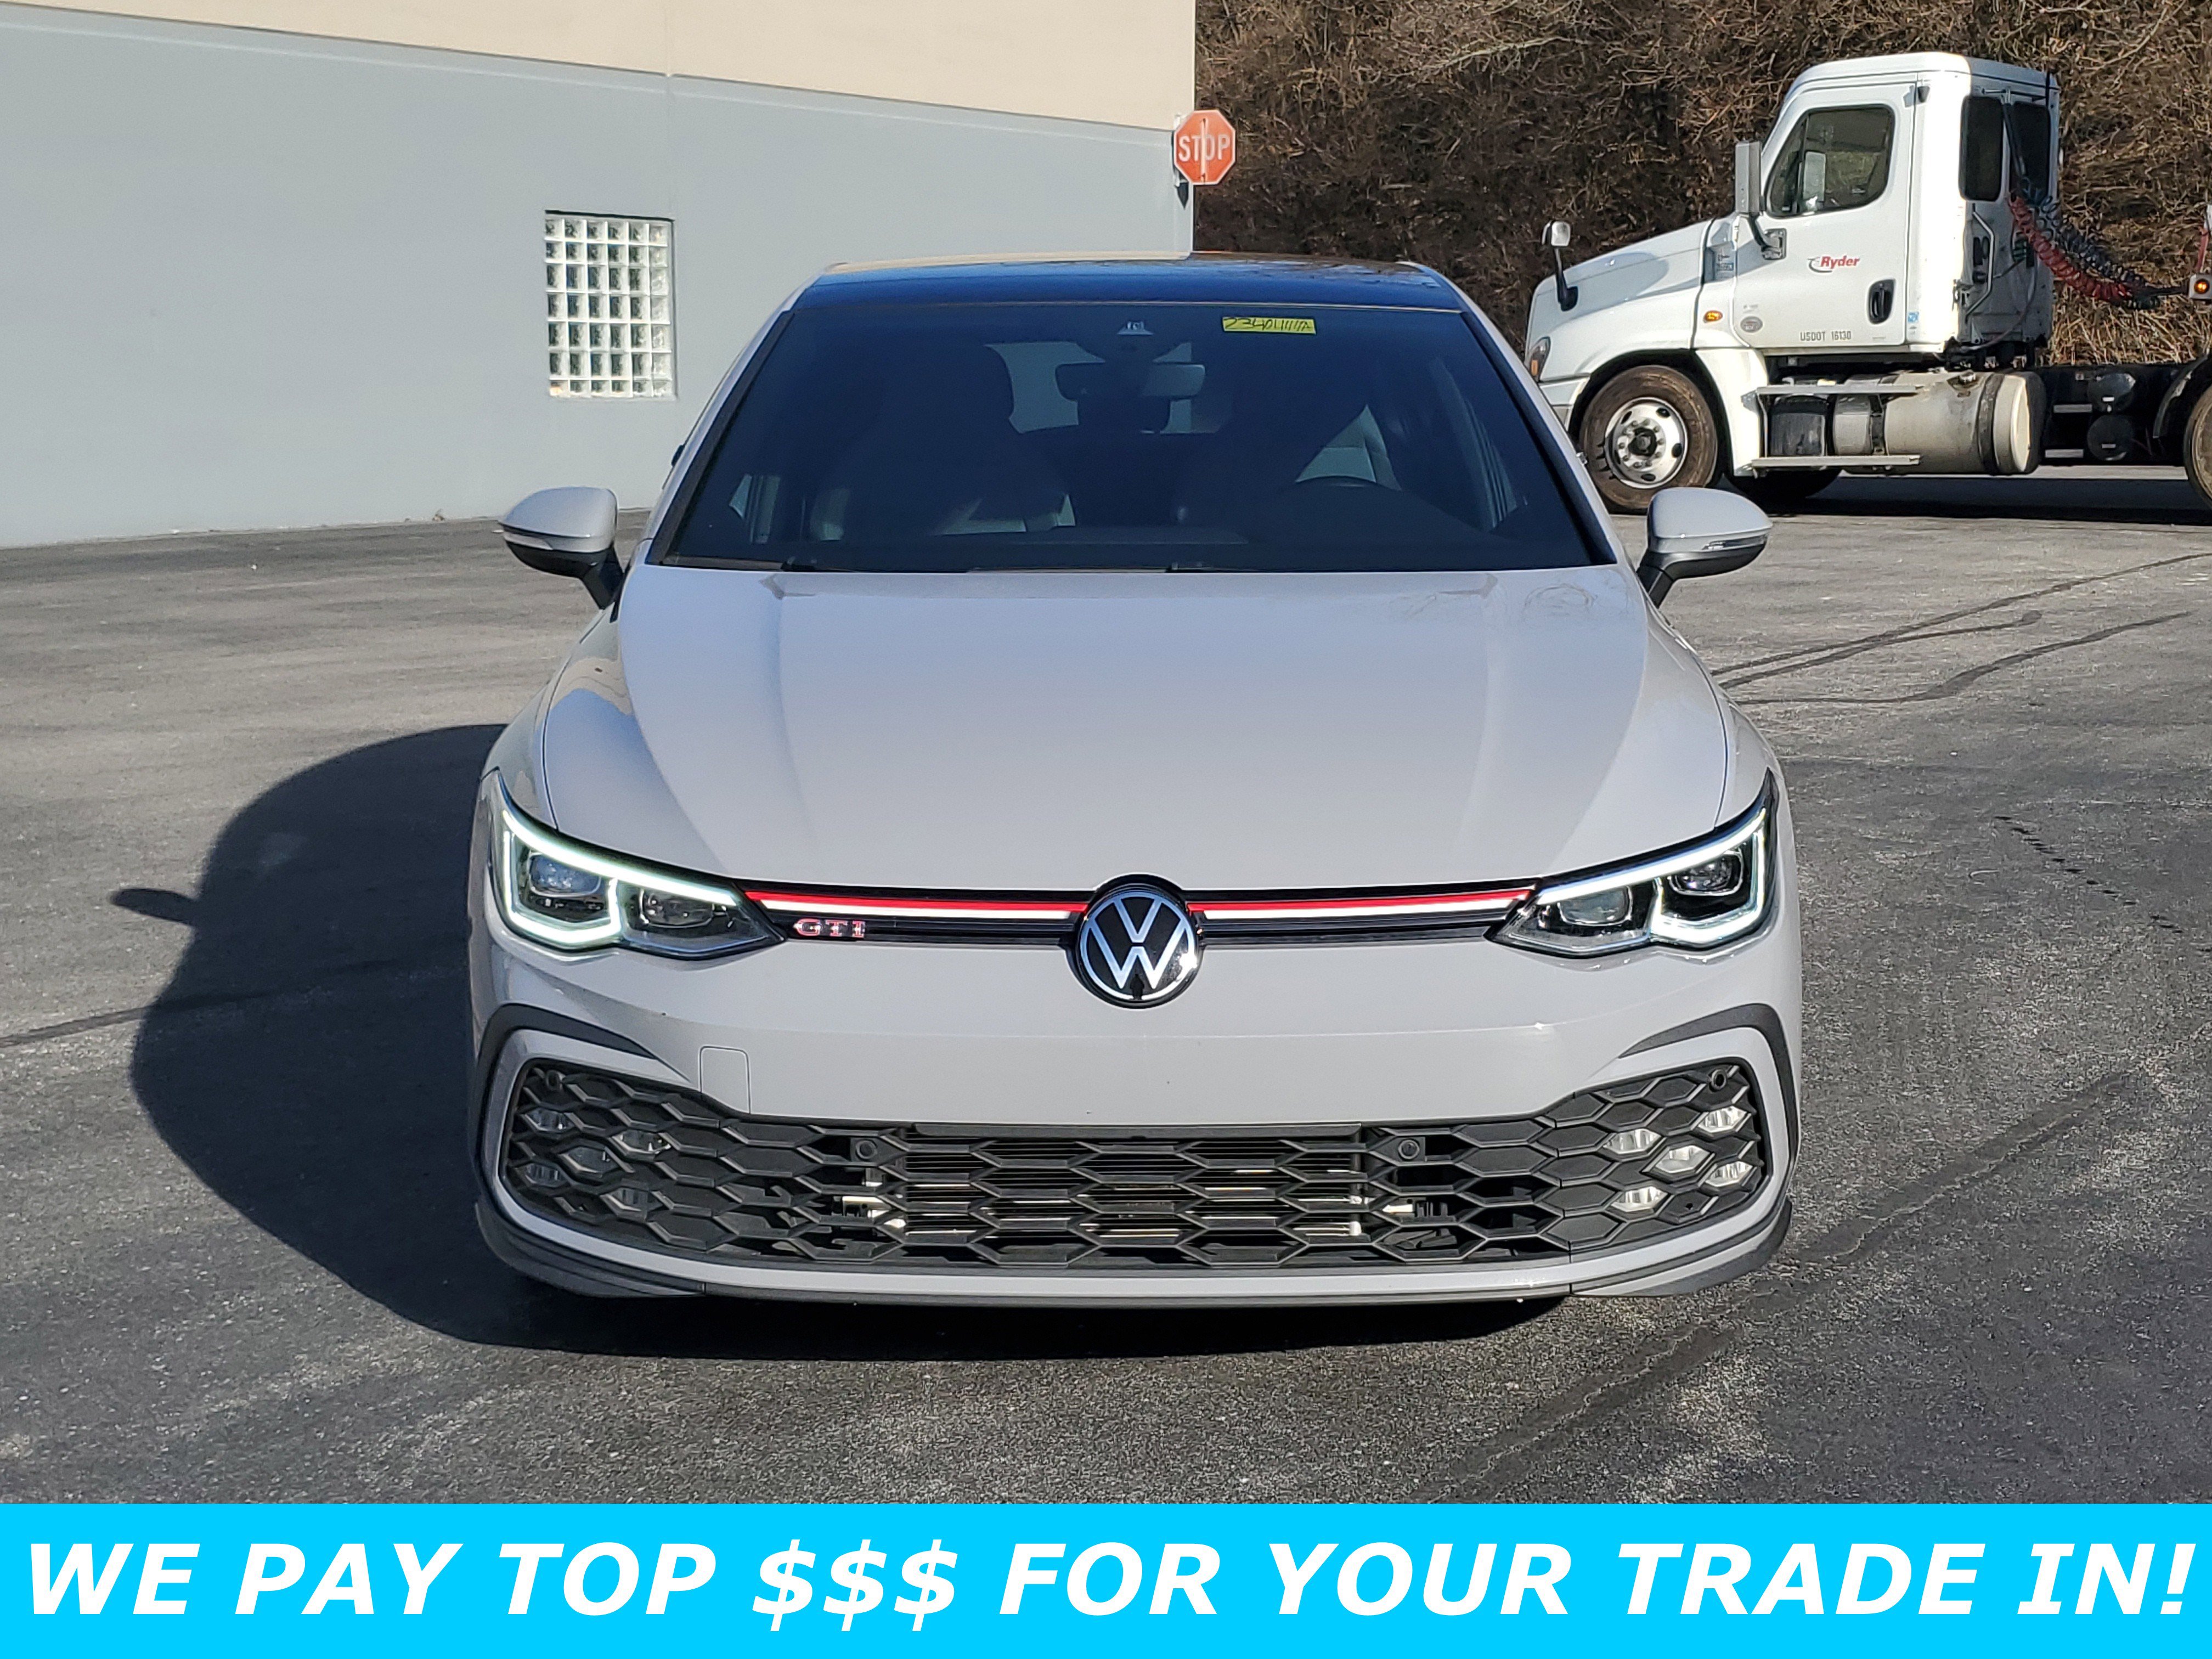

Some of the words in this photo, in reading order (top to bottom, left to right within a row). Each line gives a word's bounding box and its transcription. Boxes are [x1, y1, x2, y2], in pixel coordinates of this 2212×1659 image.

[1178, 134, 1230, 162] STOP
[1820, 255, 1860, 269] Ryder
[1800, 331, 1825, 341] USDOT
[1831, 331, 1852, 340] 16130
[793, 918, 866, 938] GTI
